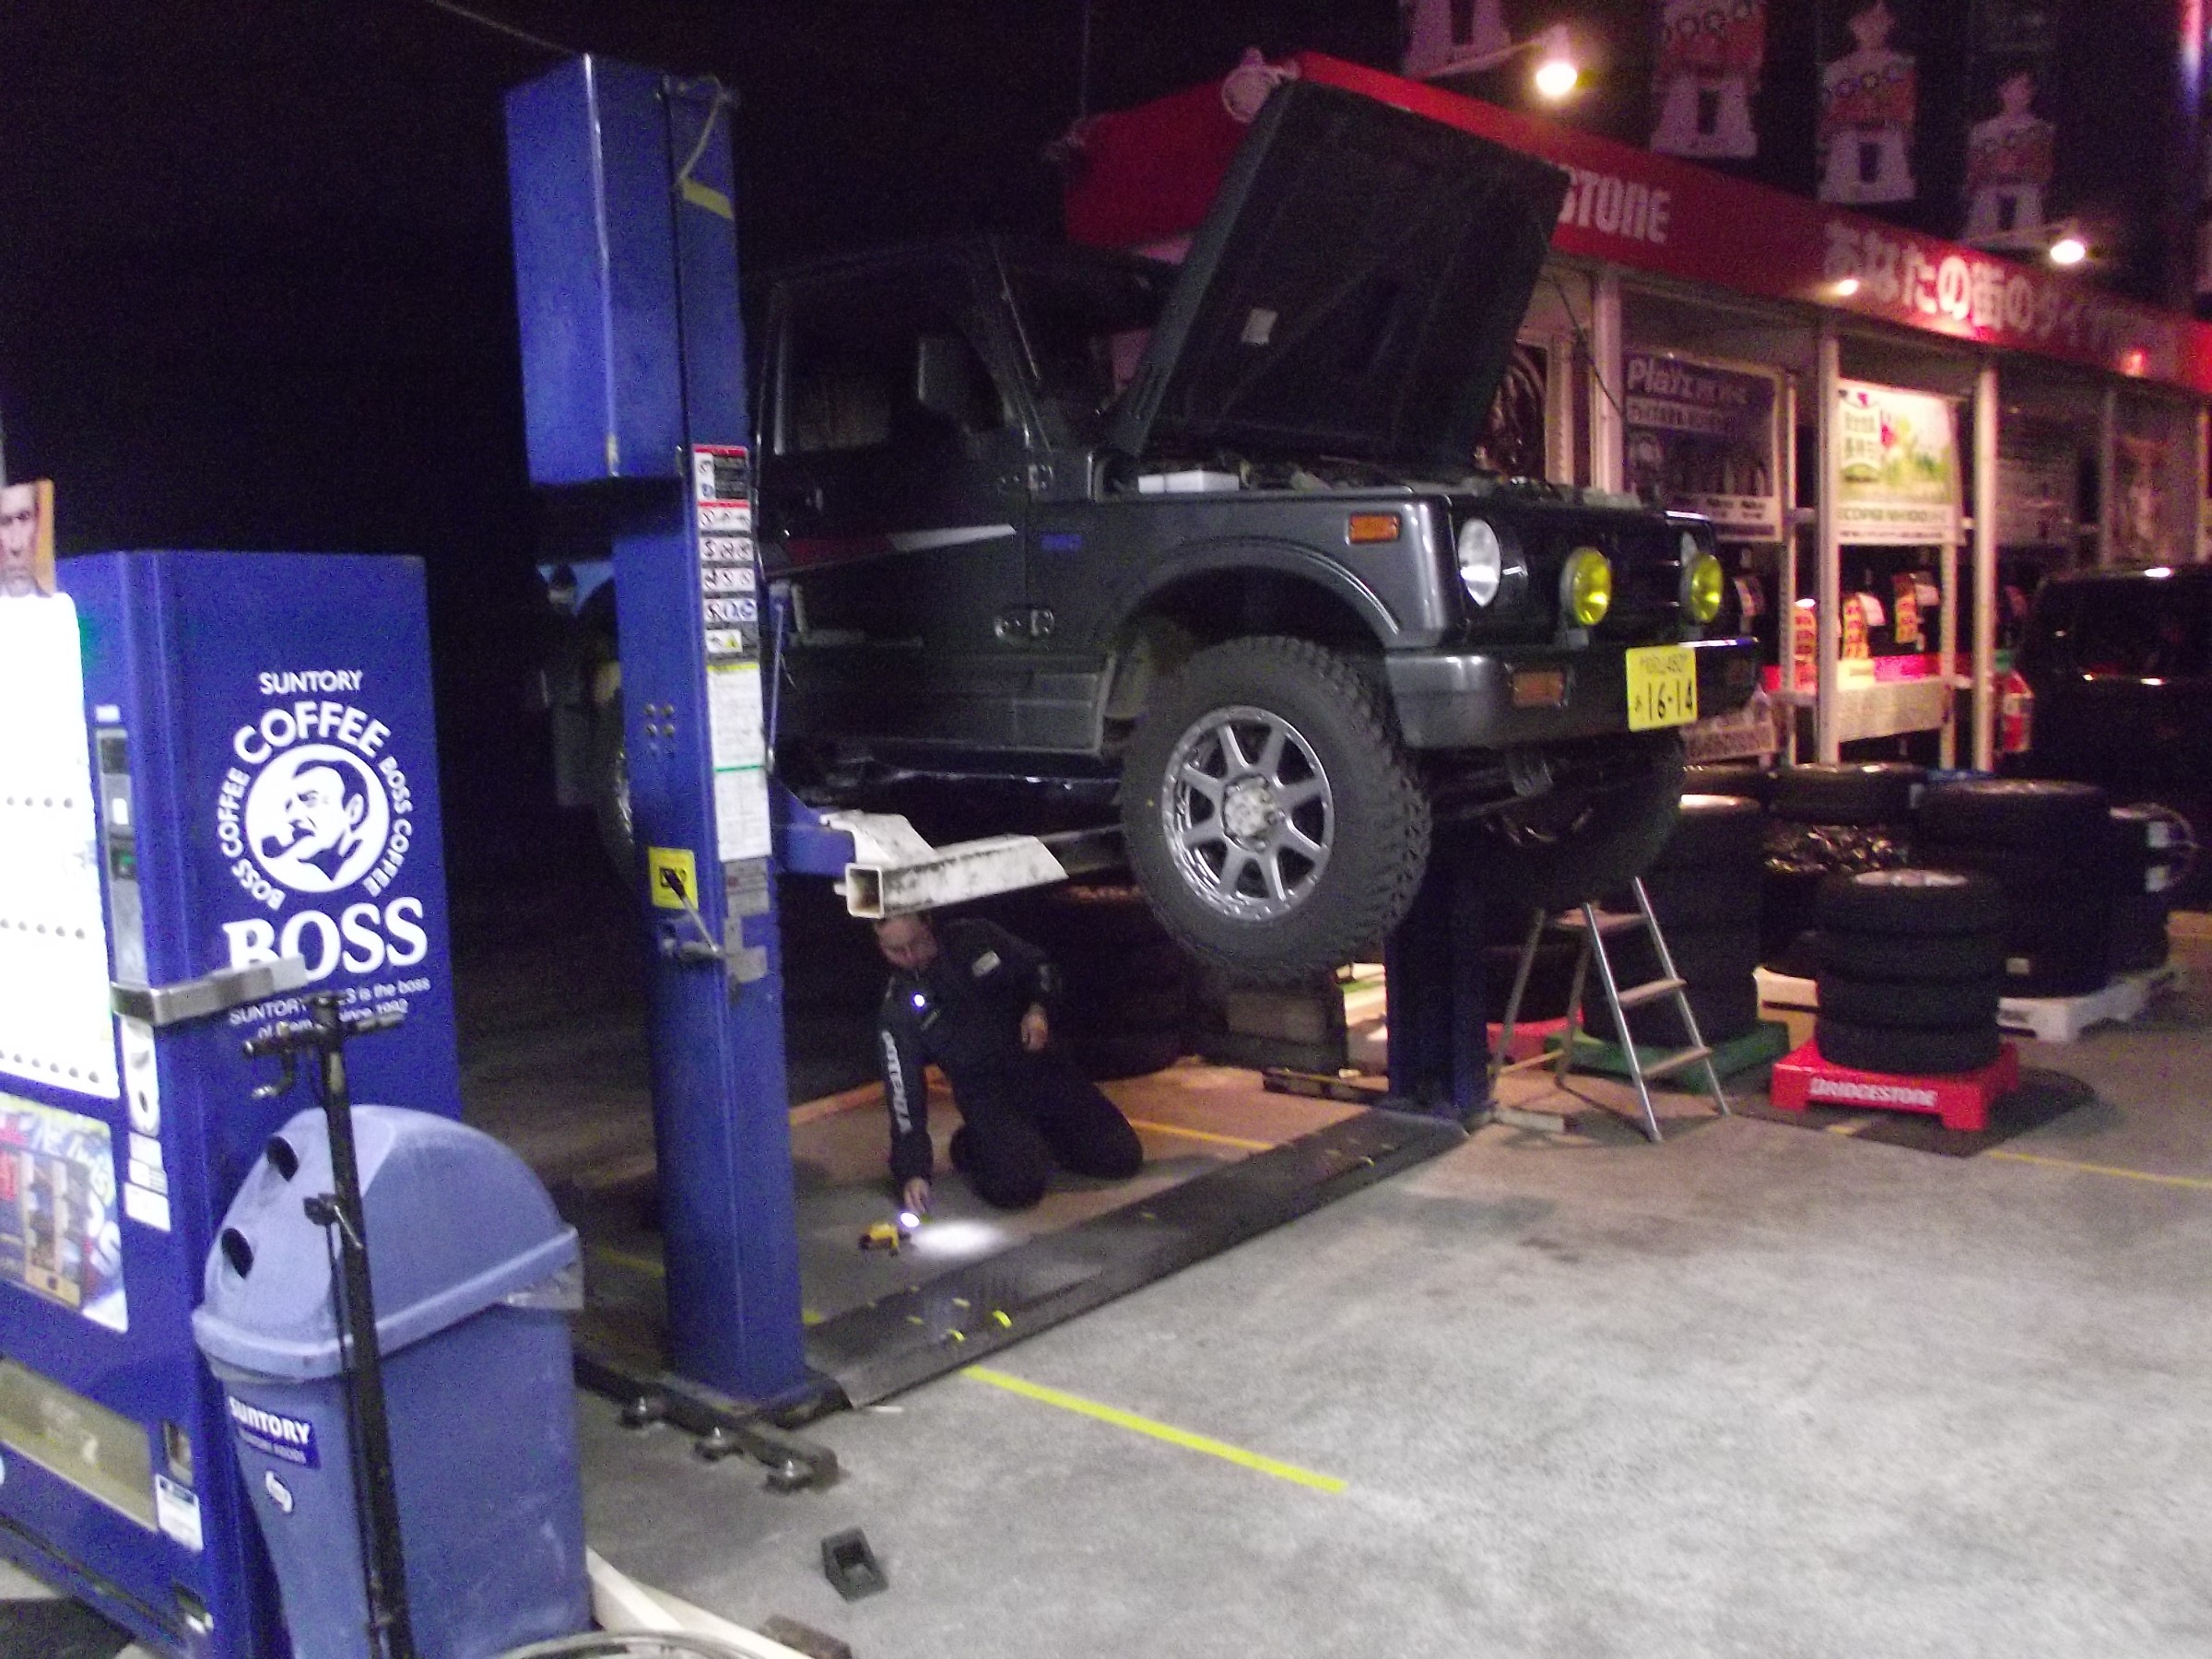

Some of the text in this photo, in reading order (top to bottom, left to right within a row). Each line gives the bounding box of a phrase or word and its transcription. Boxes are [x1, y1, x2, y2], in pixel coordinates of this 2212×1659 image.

[258, 669, 364, 695] SUNTORY
[234, 700, 392, 765] COFFEE
[218, 767, 287, 911] BOSS COFFEE
[361, 756, 414, 898] BOSS COFFEE
[221, 896, 429, 982] BOSS
[228, 1395, 311, 1445] SUNTORY
